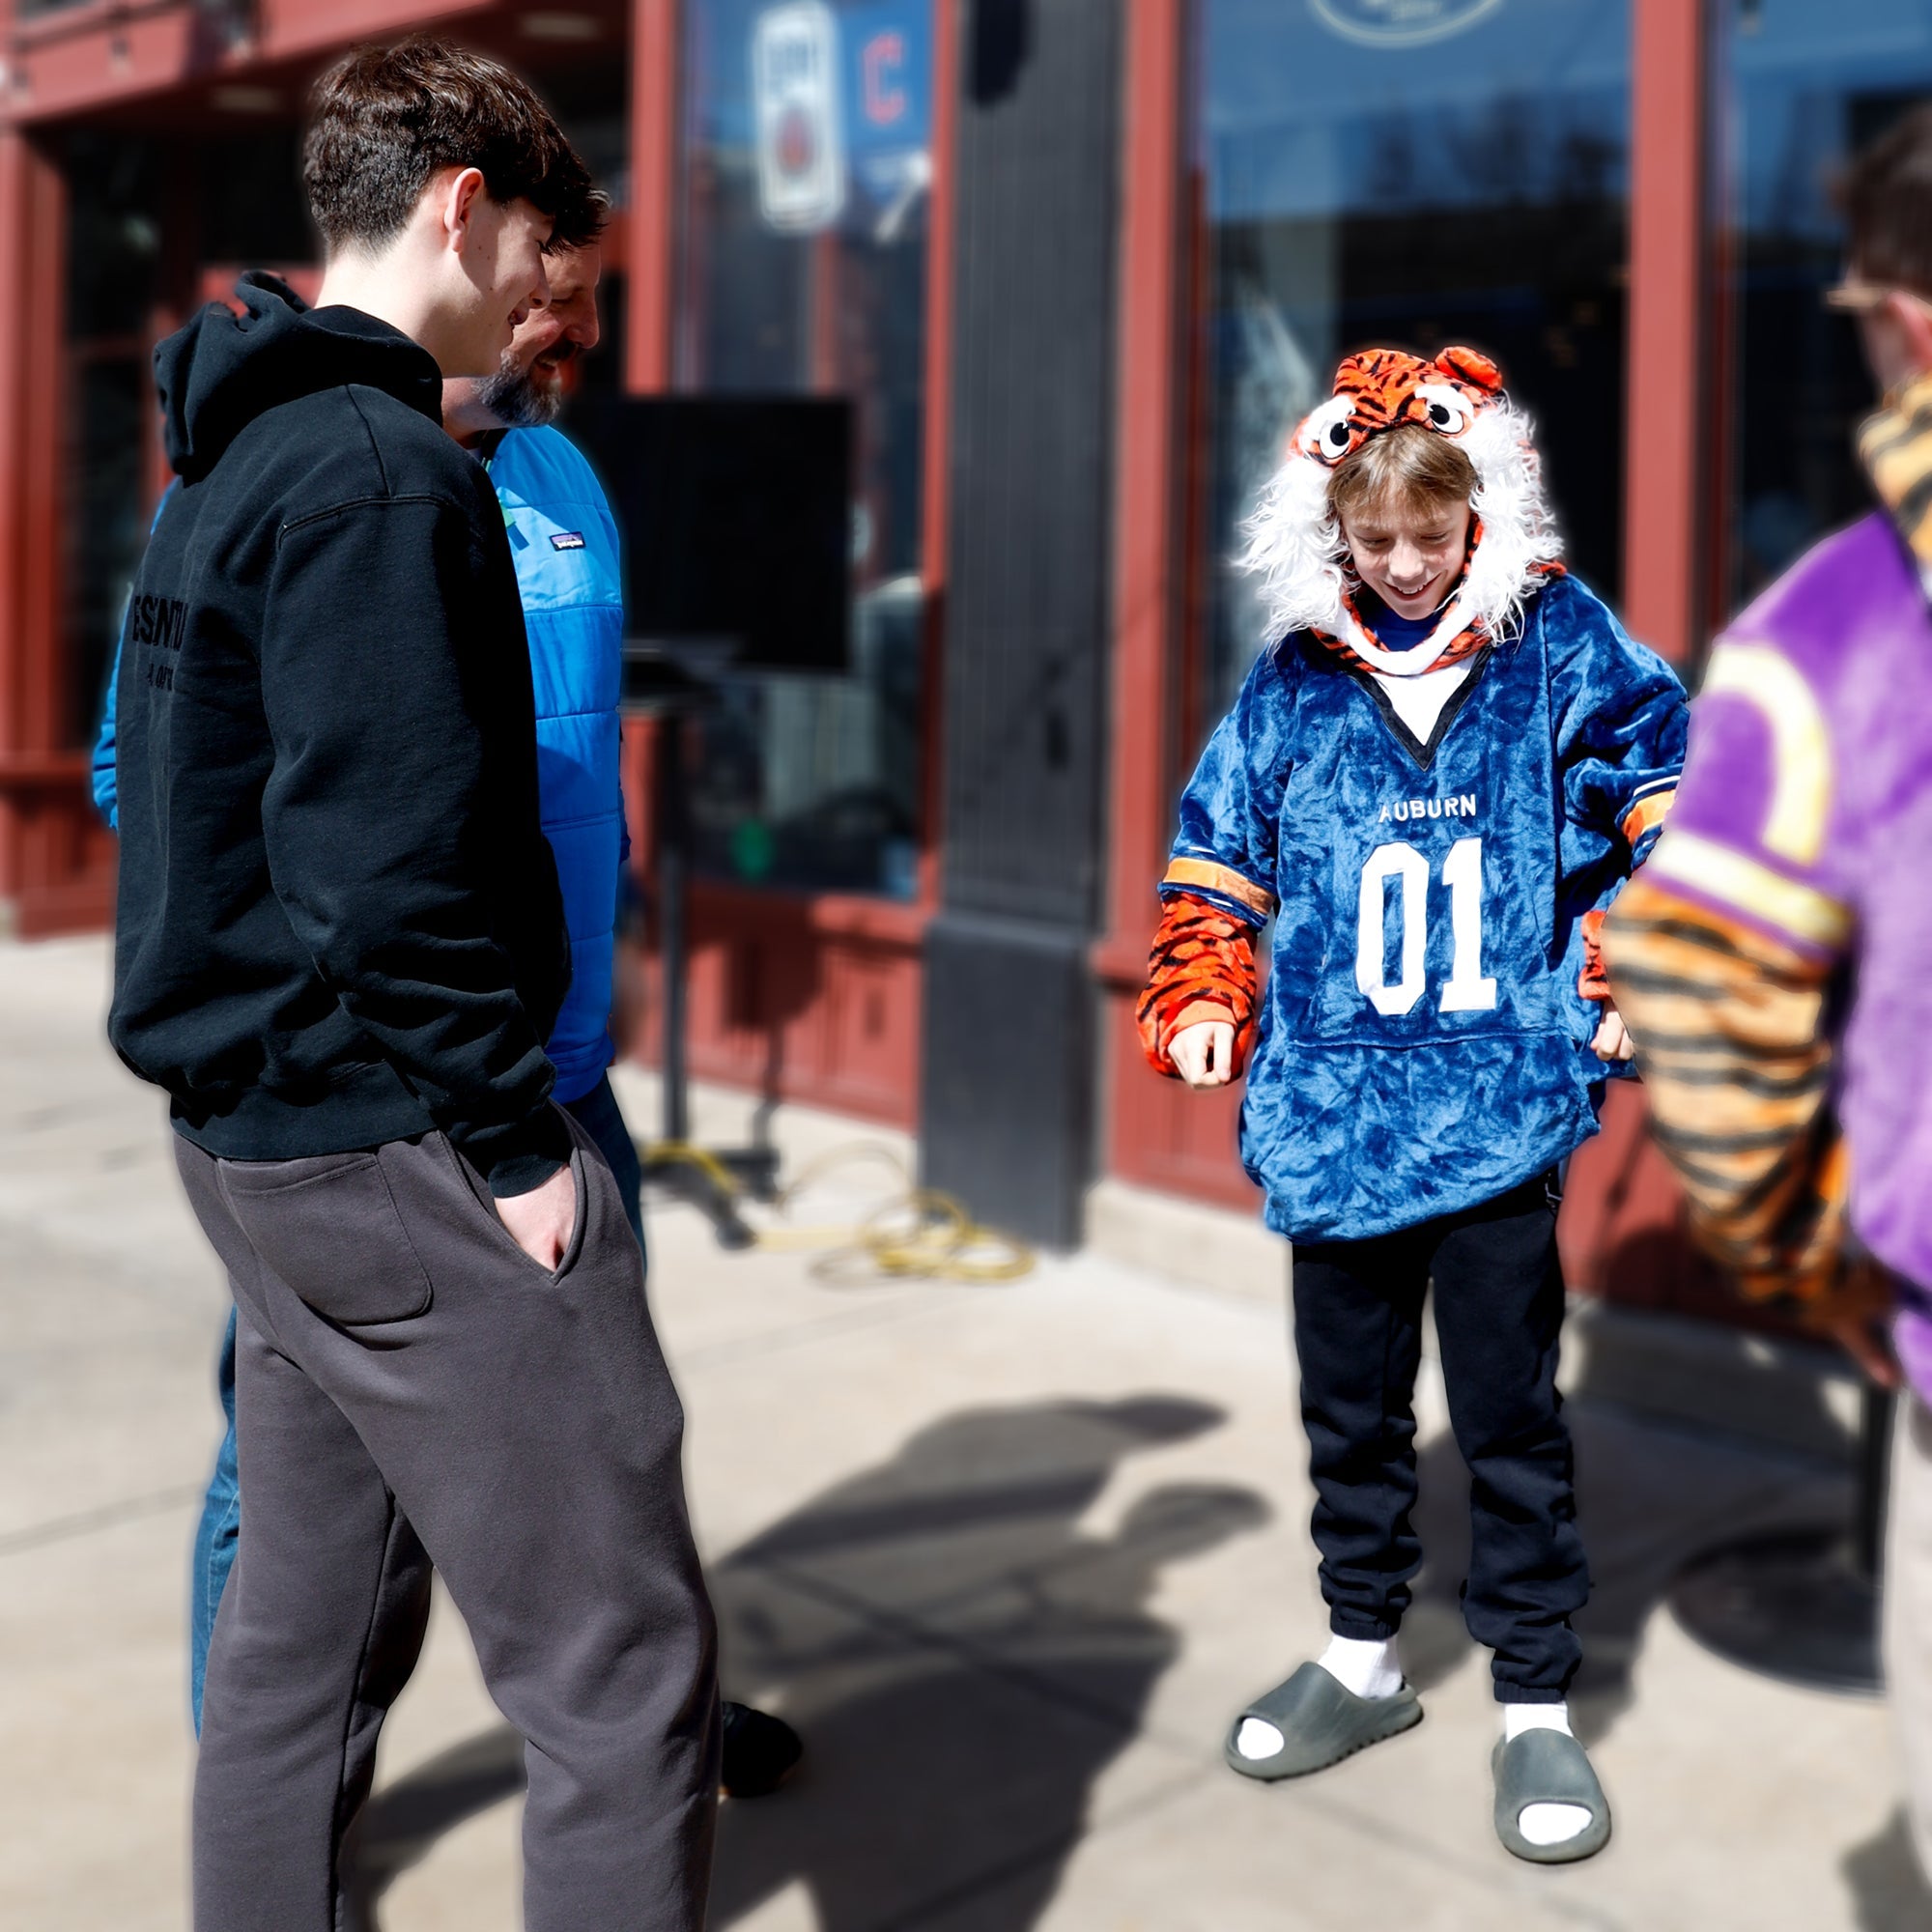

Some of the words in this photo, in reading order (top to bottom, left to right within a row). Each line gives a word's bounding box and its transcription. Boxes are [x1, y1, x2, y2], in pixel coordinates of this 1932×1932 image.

[862, 33, 905, 124] C
[1378, 794, 1476, 822] AUBURN
[1355, 837, 1497, 1015] 01
